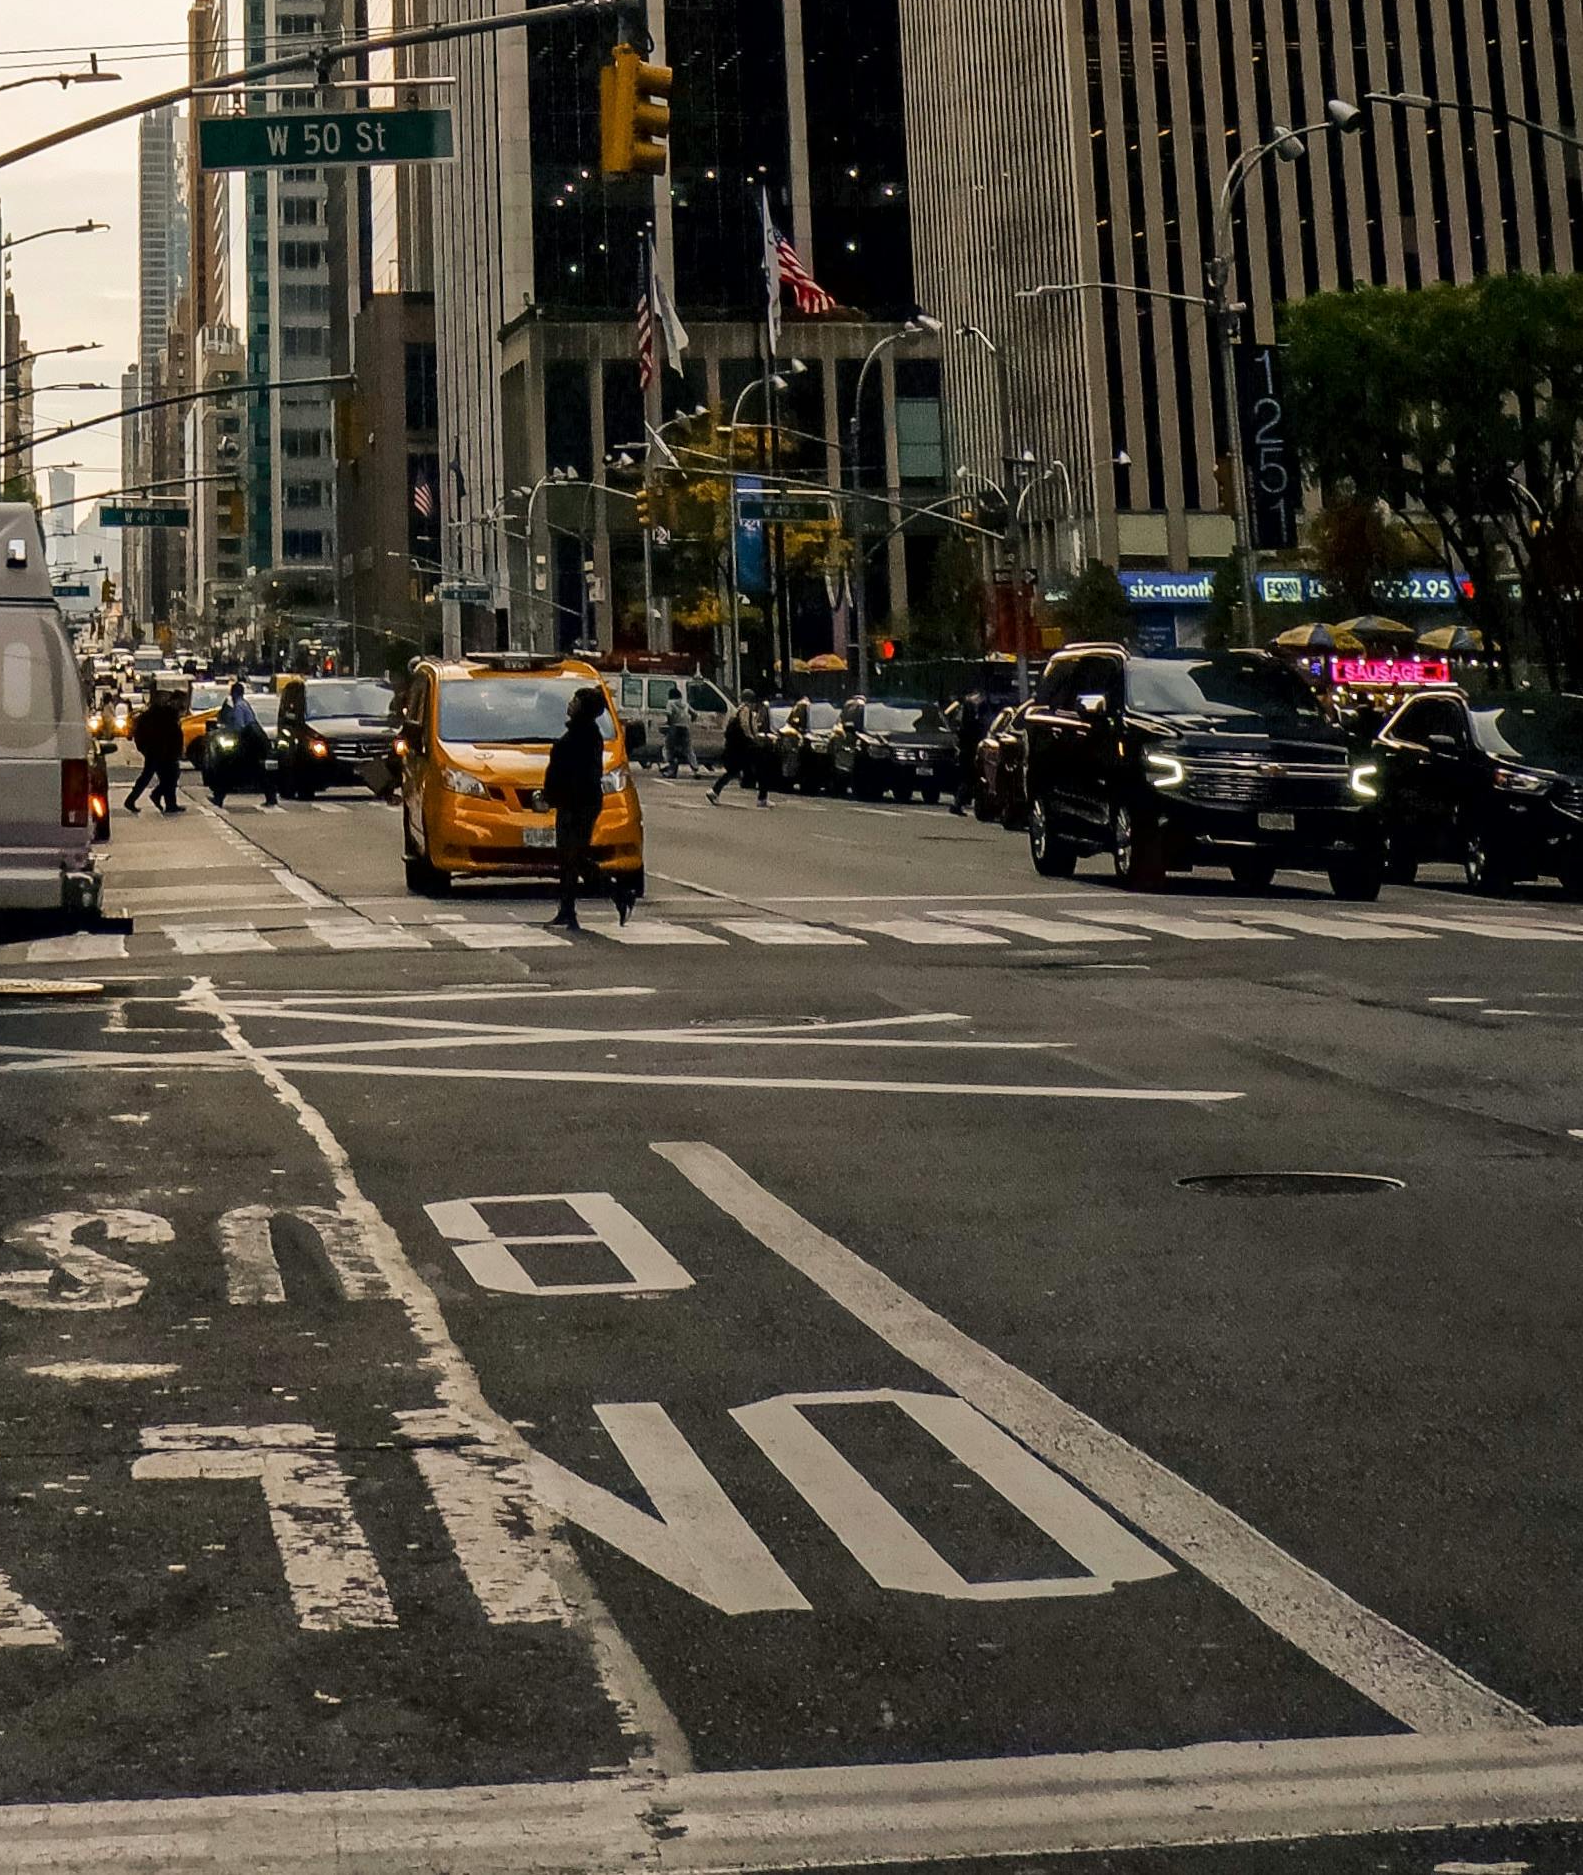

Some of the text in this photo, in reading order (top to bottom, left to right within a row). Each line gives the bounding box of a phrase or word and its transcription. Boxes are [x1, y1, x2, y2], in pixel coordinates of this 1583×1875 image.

[266, 120, 386, 157] W 50 St
[124, 511, 133, 524] W
[1344, 664, 1425, 681] SAUSAGE
